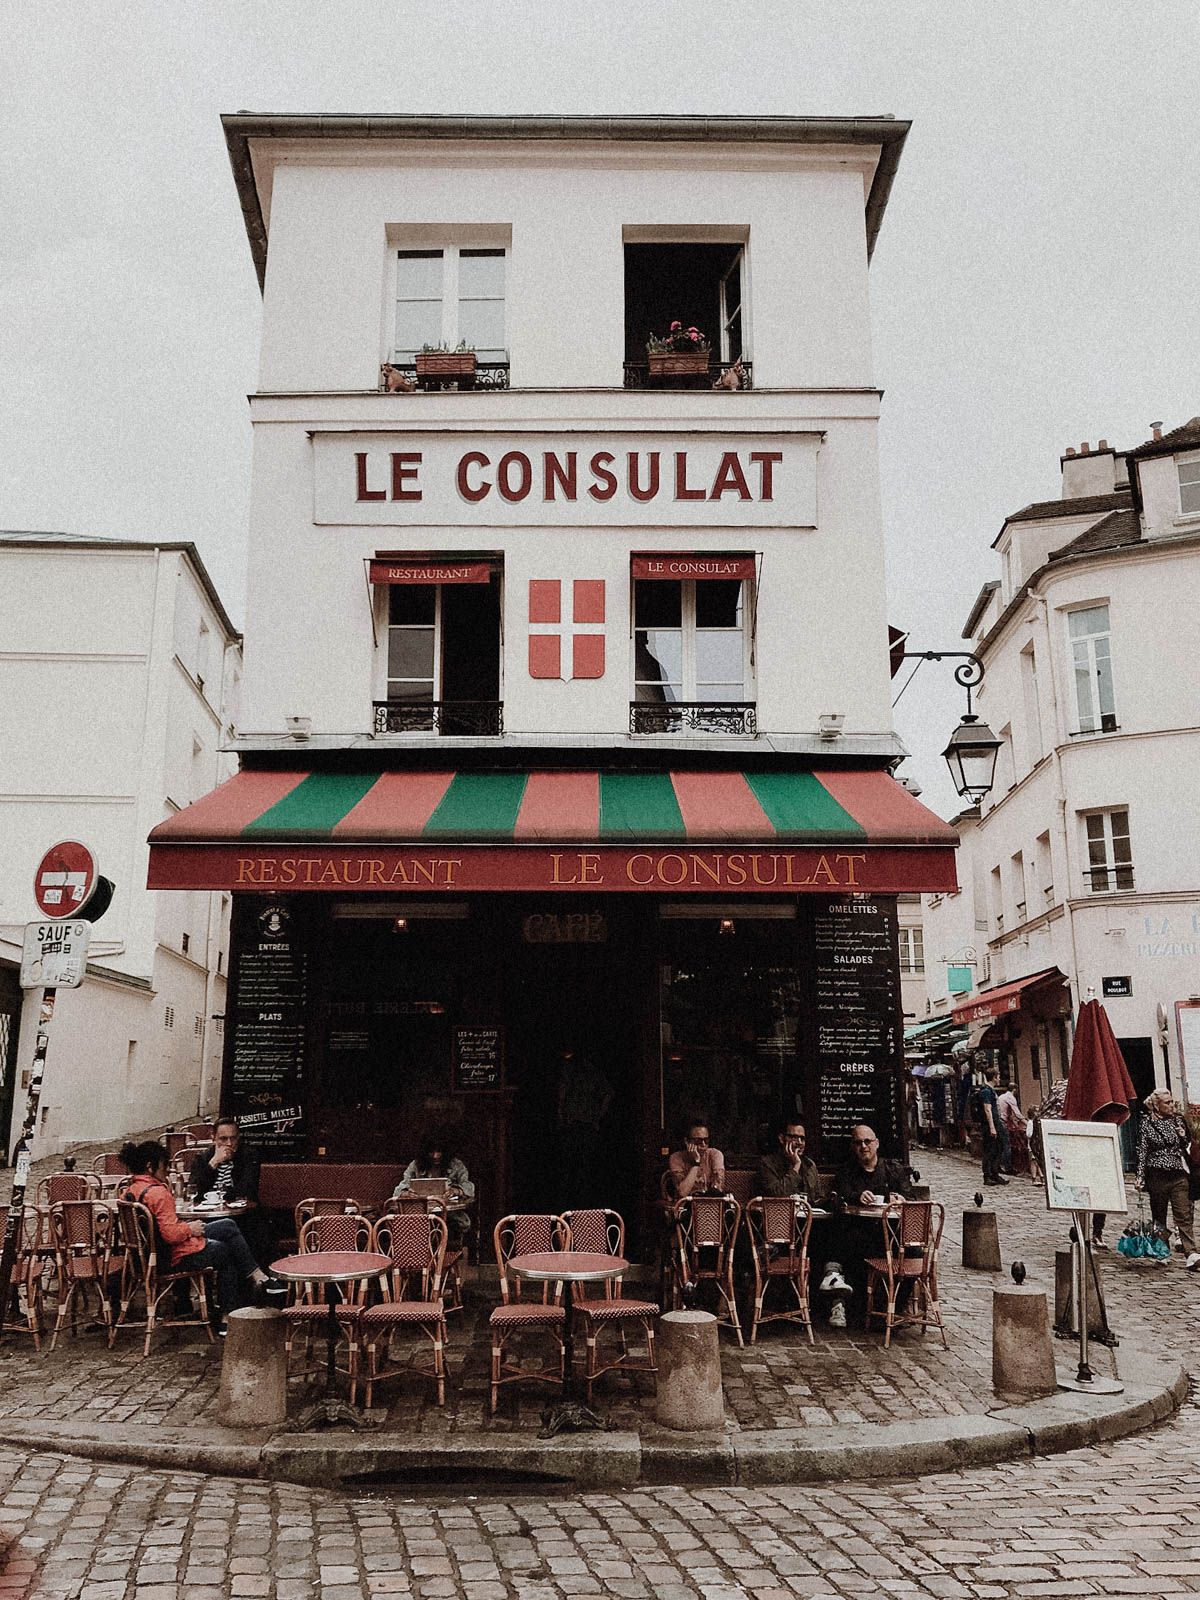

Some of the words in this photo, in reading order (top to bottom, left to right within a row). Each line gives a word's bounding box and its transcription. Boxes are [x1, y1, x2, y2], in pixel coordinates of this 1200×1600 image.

[354, 451, 423, 502] LE
[455, 451, 783, 503] CONSULAT
[388, 568, 471, 578] RESTAURANT
[648, 562, 664, 572] LE
[669, 562, 740, 573] CONSULAT
[235, 858, 462, 884] RESTAURANT
[549, 854, 604, 884] LE
[626, 853, 867, 885] CONSULAT
[829, 904, 878, 914] OMELETTES
[38, 925, 72, 941] SAUF
[258, 943, 290, 951] ENTRÉES
[834, 955, 873, 964] SALADES
[259, 1013, 282, 1021] PLATS
[840, 1062, 875, 1073] CRÊPES
[271, 1107, 296, 1119] MIXTE
